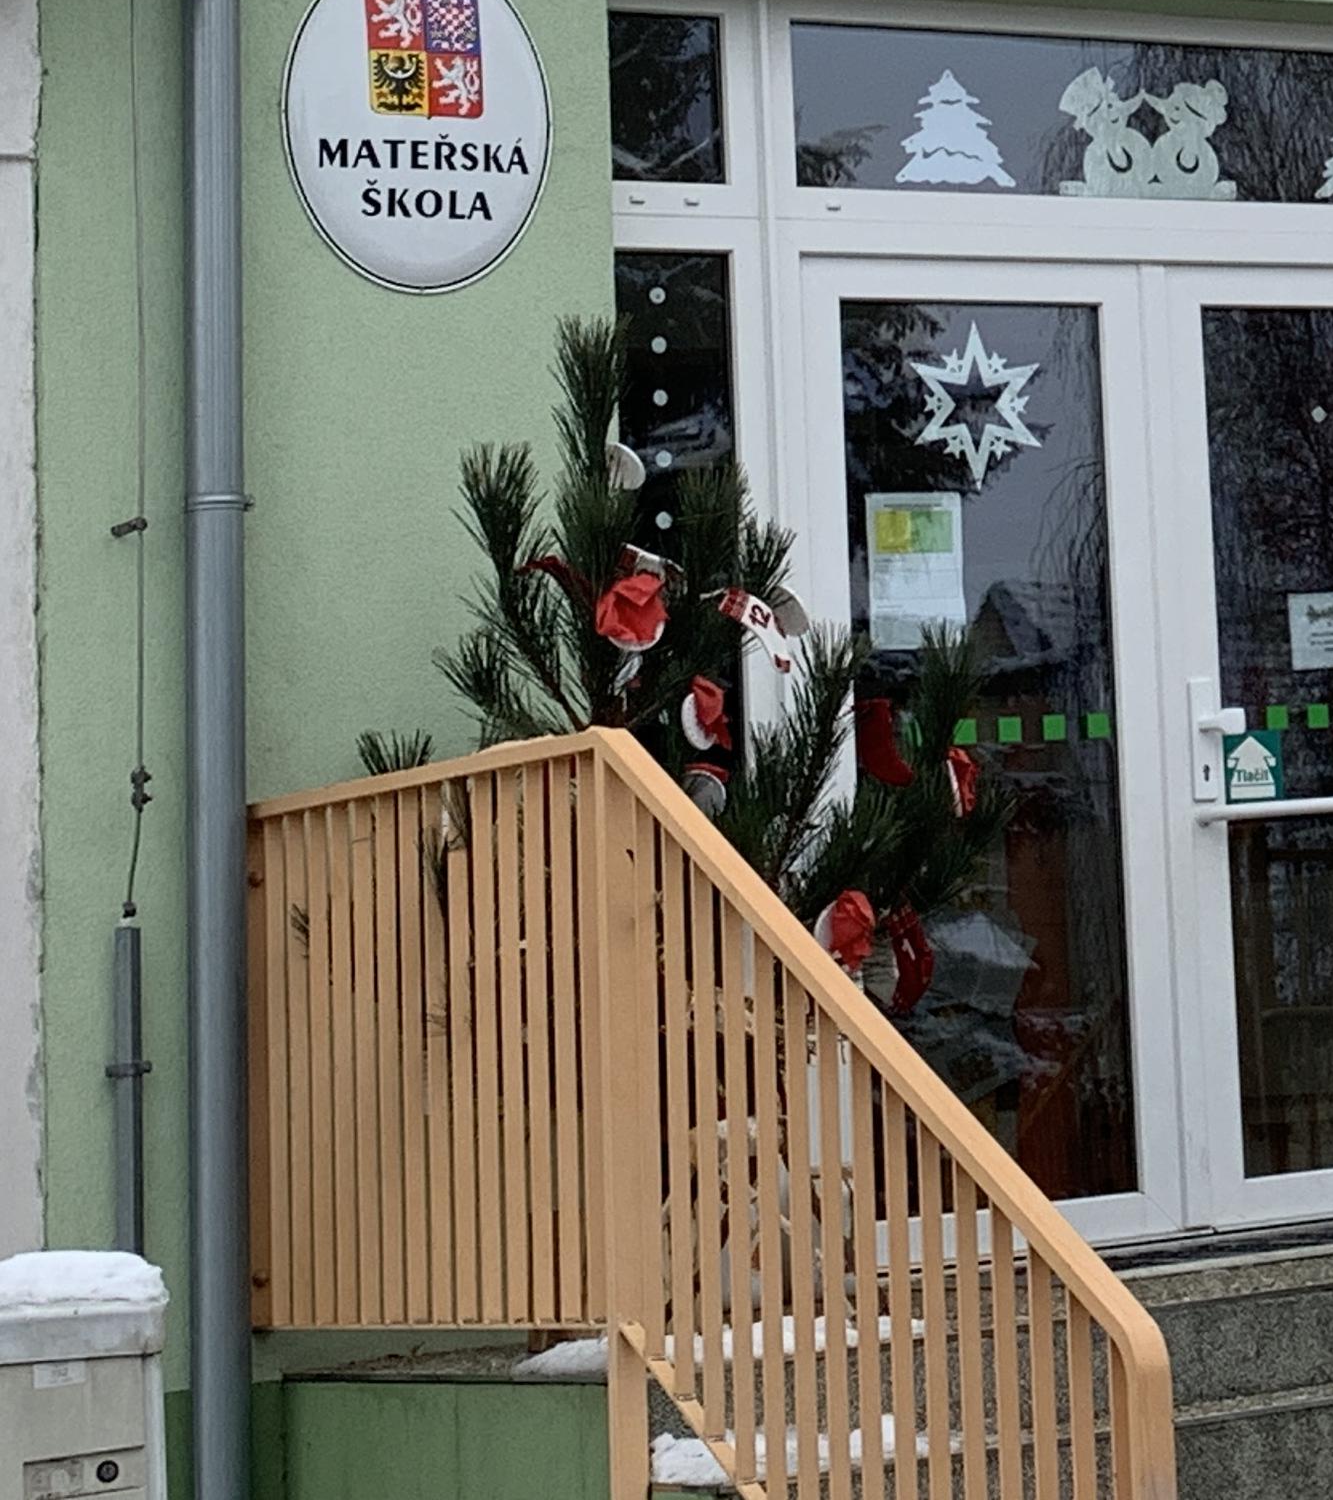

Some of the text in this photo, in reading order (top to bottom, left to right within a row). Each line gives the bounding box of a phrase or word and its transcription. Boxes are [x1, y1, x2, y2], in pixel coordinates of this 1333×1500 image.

[318, 133, 530, 175] MATEŘSKÁ
[361, 180, 493, 221] ŠKOLA
[748, 604, 771, 629] 12
